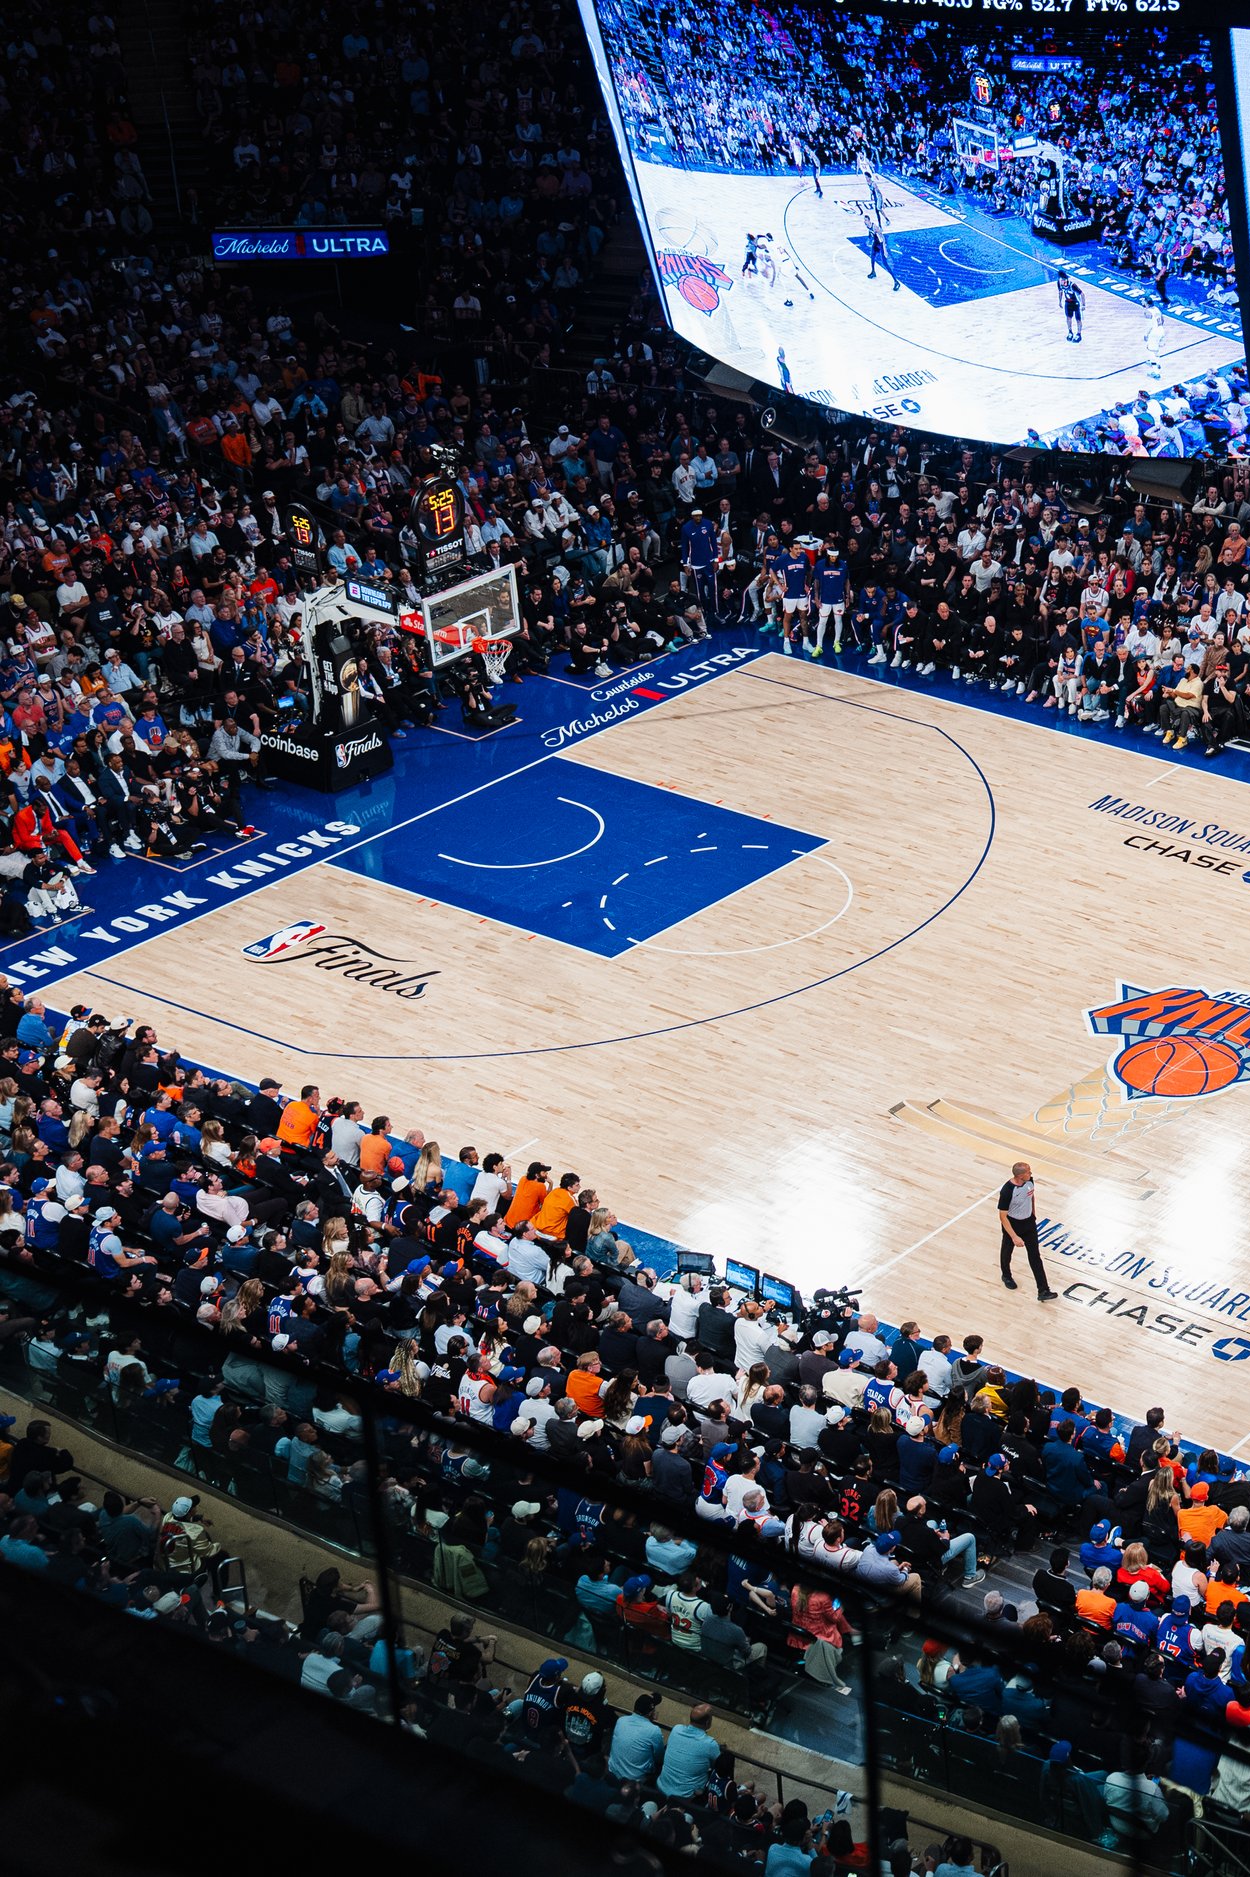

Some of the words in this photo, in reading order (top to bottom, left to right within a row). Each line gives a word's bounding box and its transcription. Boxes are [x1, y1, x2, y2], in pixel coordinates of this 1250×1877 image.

[214, 238, 289, 256] Michelob
[312, 238, 387, 252] ULTRA
[1050, 257, 1095, 276] NEW
[1168, 305, 1243, 337] KNIC
[428, 488, 454, 511] 5:25
[292, 515, 310, 530] 5:25
[434, 504, 456, 535] 13
[296, 527, 310, 545] 13
[436, 538, 463, 552] TISSOT
[656, 646, 760, 690] ULTRA
[590, 671, 654, 702] Courtside
[540, 697, 640, 748] Michelob
[260, 733, 320, 762] coinbase
[343, 732, 383, 768] Finals
[1087, 794, 1197, 834] MADISON
[1122, 835, 1244, 876] CHASE
[80, 889, 209, 944] YORK
[205, 820, 361, 891] KNICKS
[246, 945, 266, 956] NBA
[260, 934, 441, 1000] Finals
[312, 1131, 324, 1149] 14
[457, 1236, 466, 1254] 11
[1035, 1217, 1156, 1280] MADISON
[269, 1314, 281, 1334] 11
[1062, 1282, 1214, 1346] CHASE
[460, 1396, 471, 1415] 11
[840, 1497, 860, 1521] 32
[1116, 1622, 1131, 1631] NEW
[1165, 1630, 1179, 1643] LIN
[1159, 1640, 1182, 1657] 17
